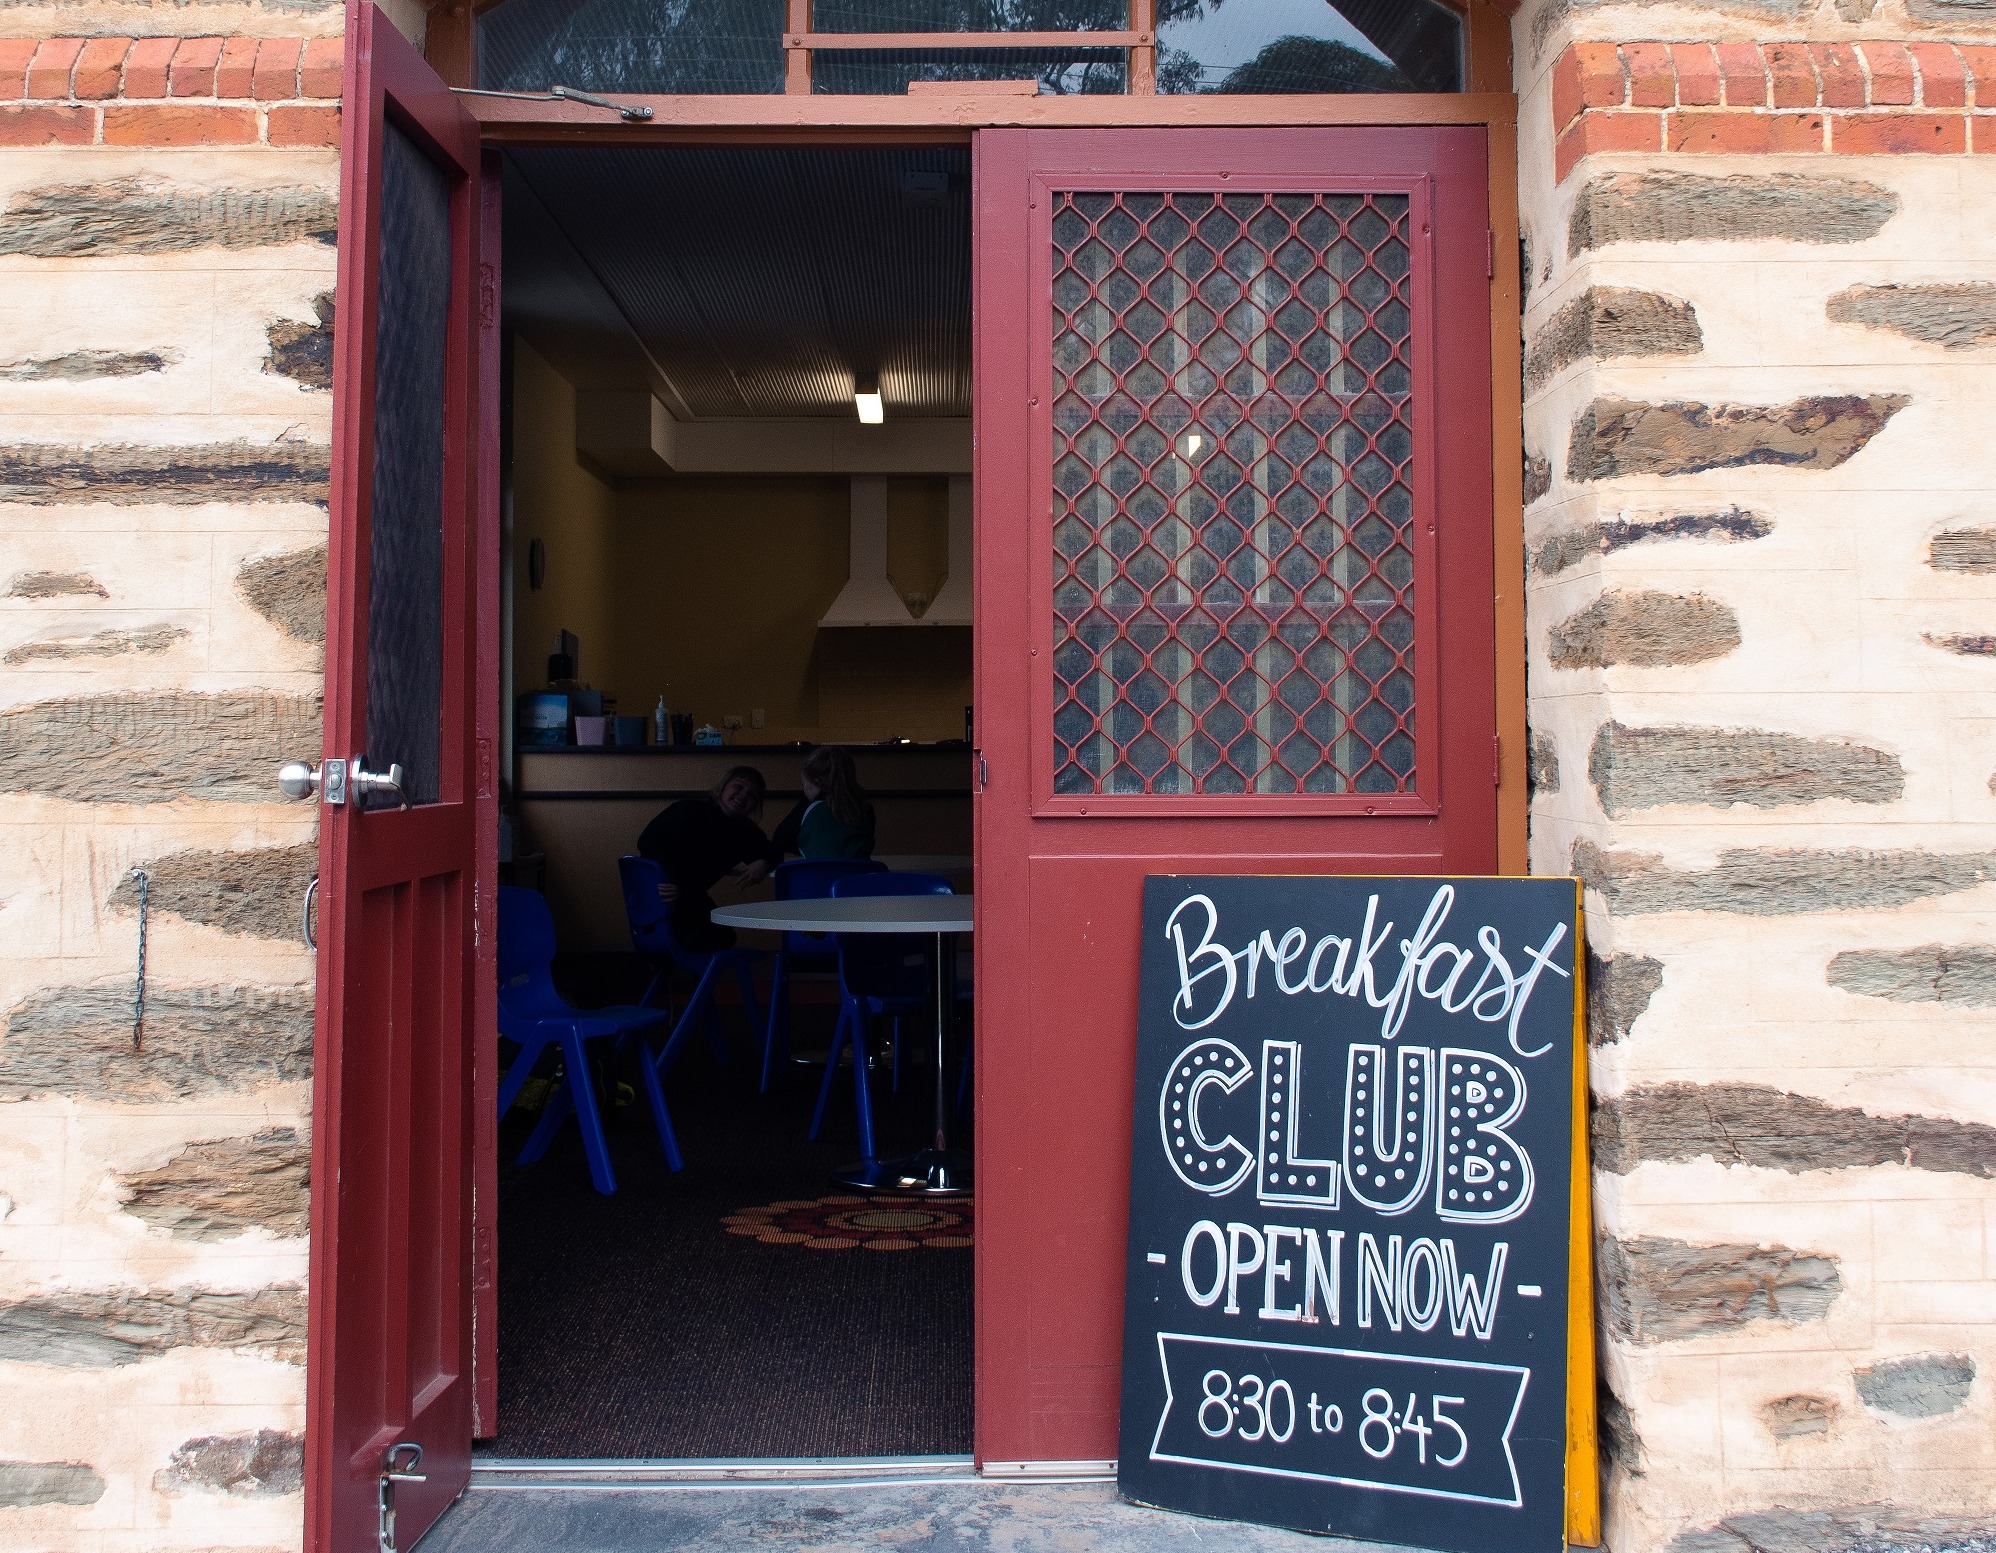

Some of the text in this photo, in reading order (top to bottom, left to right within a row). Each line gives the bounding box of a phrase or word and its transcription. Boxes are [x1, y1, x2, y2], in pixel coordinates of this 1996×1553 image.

[1165, 884, 1571, 1056] Breakfast
[1159, 1038, 1535, 1224] CLUB
[1181, 1220, 1508, 1339] OPEN NOW
[1198, 1369, 1468, 1467] 8:30 to 8:45
